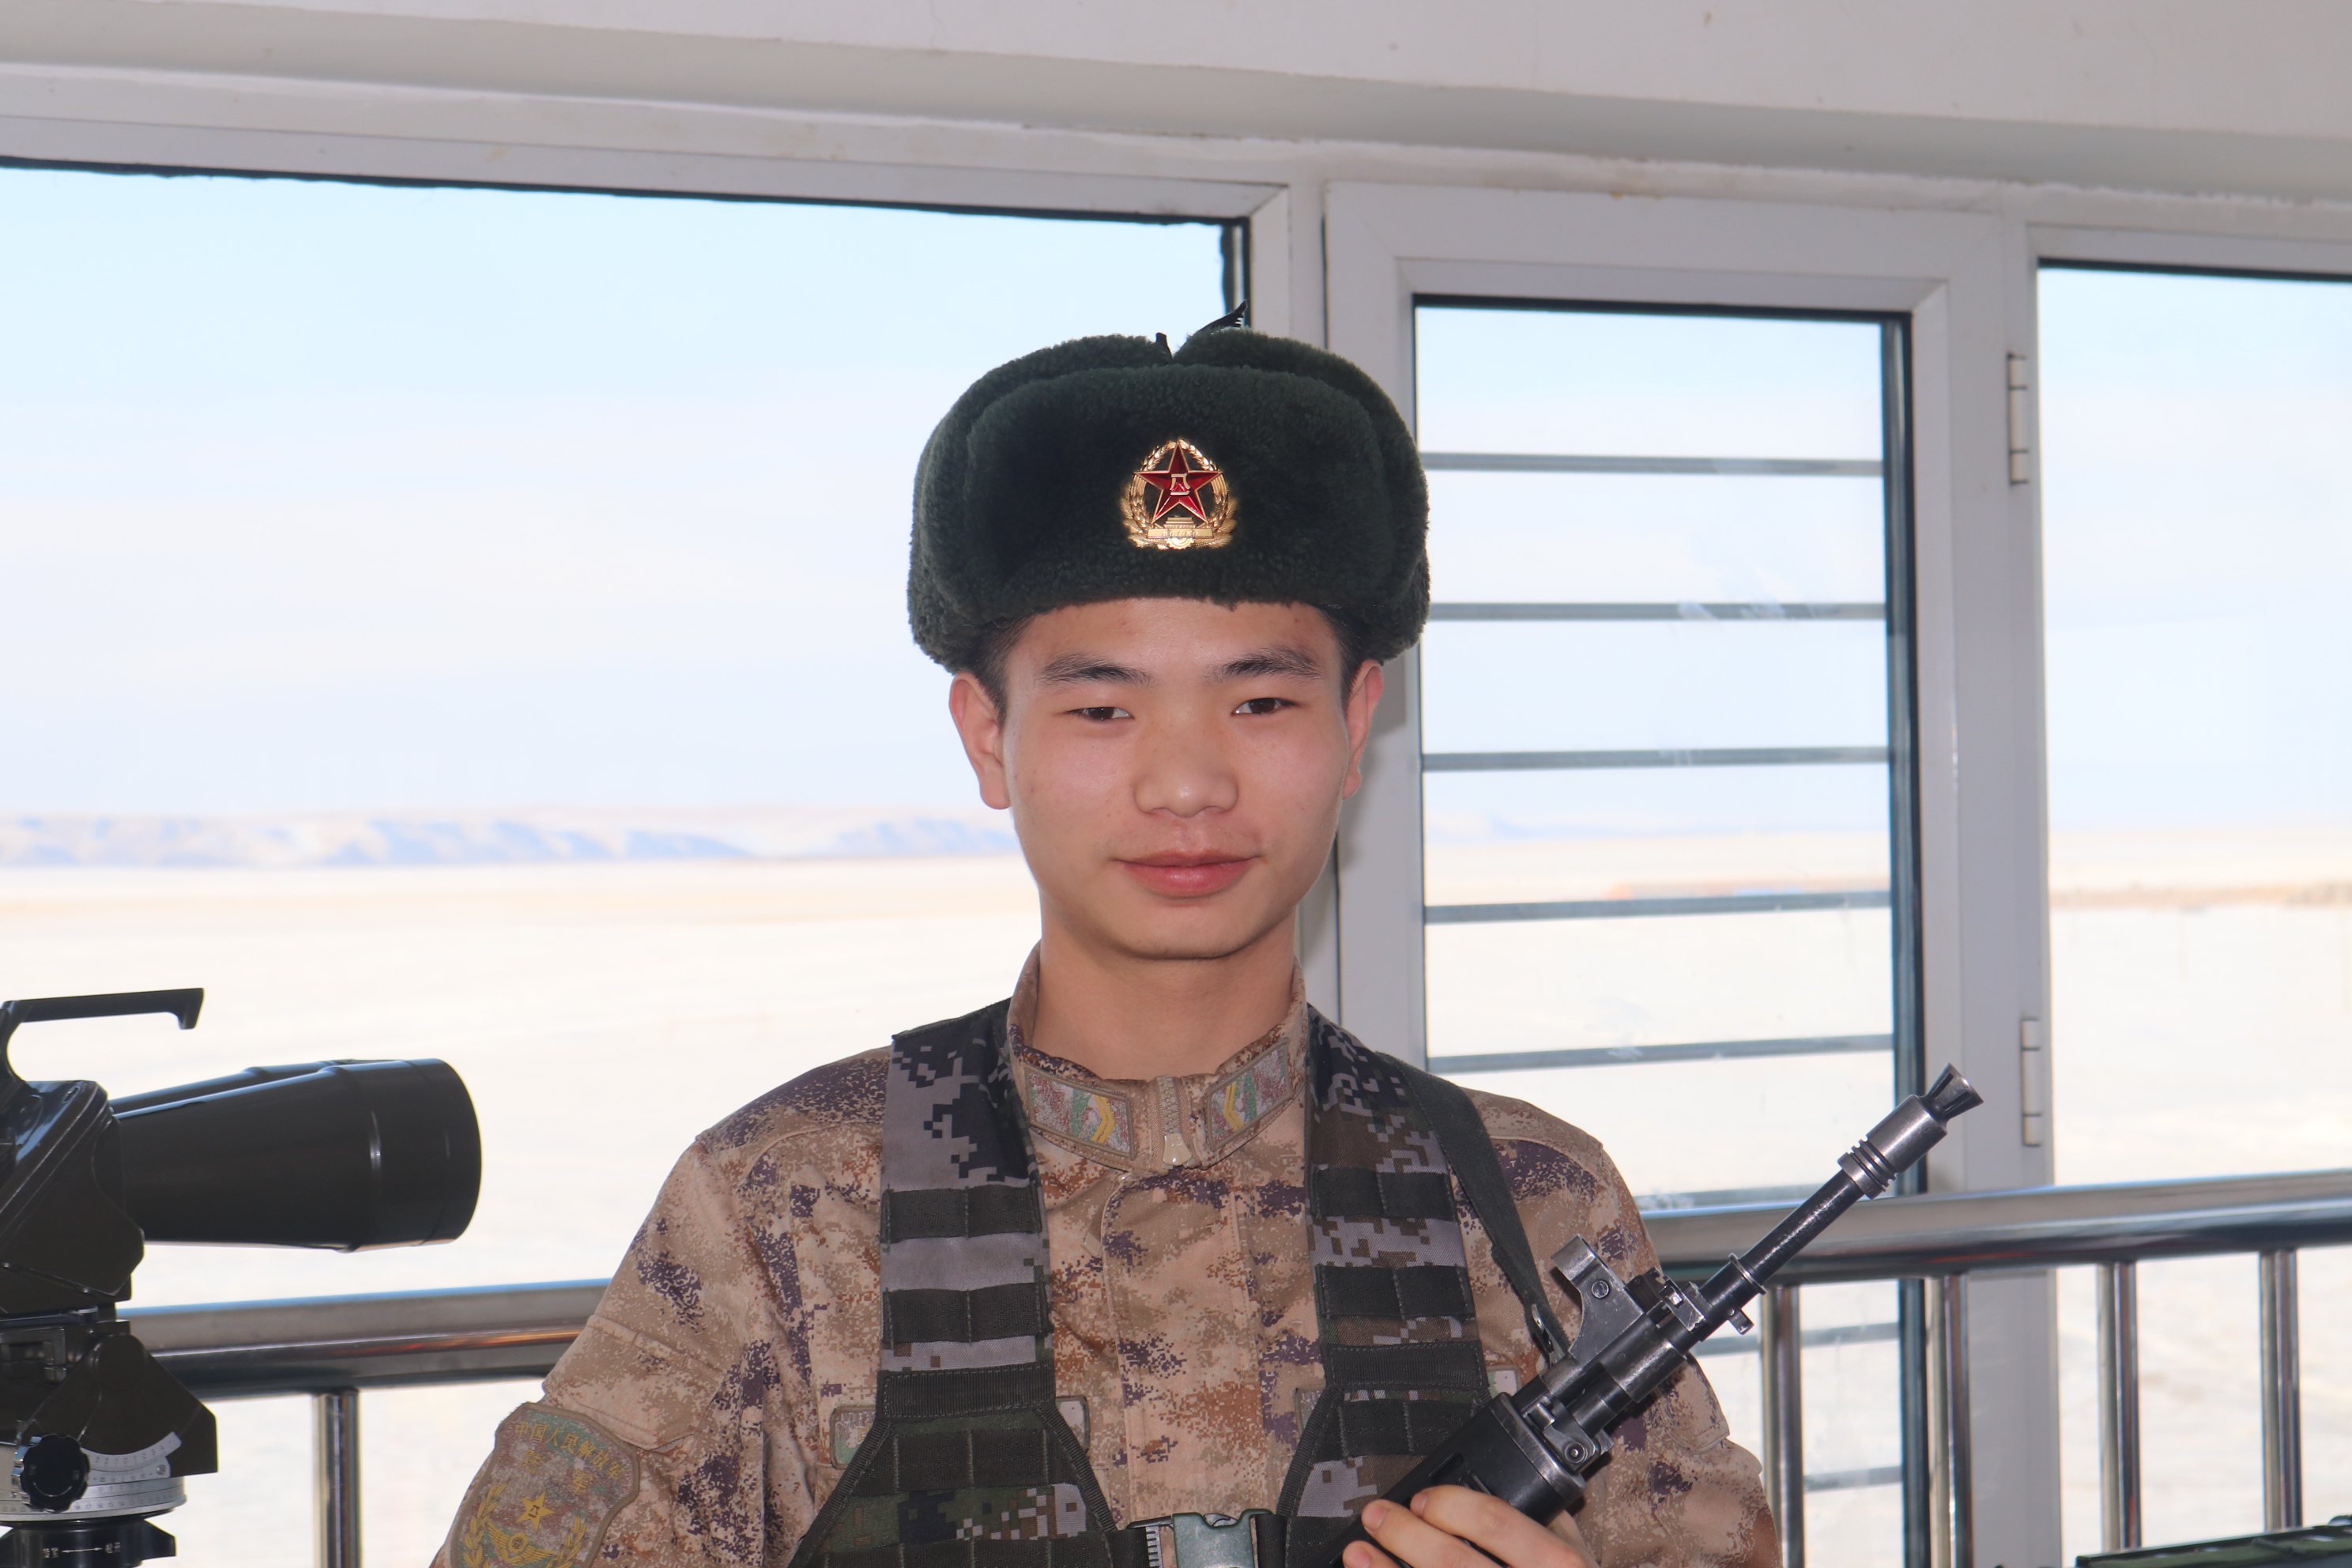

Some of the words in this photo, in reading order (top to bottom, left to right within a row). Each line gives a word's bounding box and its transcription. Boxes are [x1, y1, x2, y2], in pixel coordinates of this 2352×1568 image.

[1170, 473, 1191, 496] 八一
[514, 1420, 625, 1481] 中国人民解放军
[518, 1448, 593, 1495] 陆军
[528, 1505, 540, 1518] 八一
